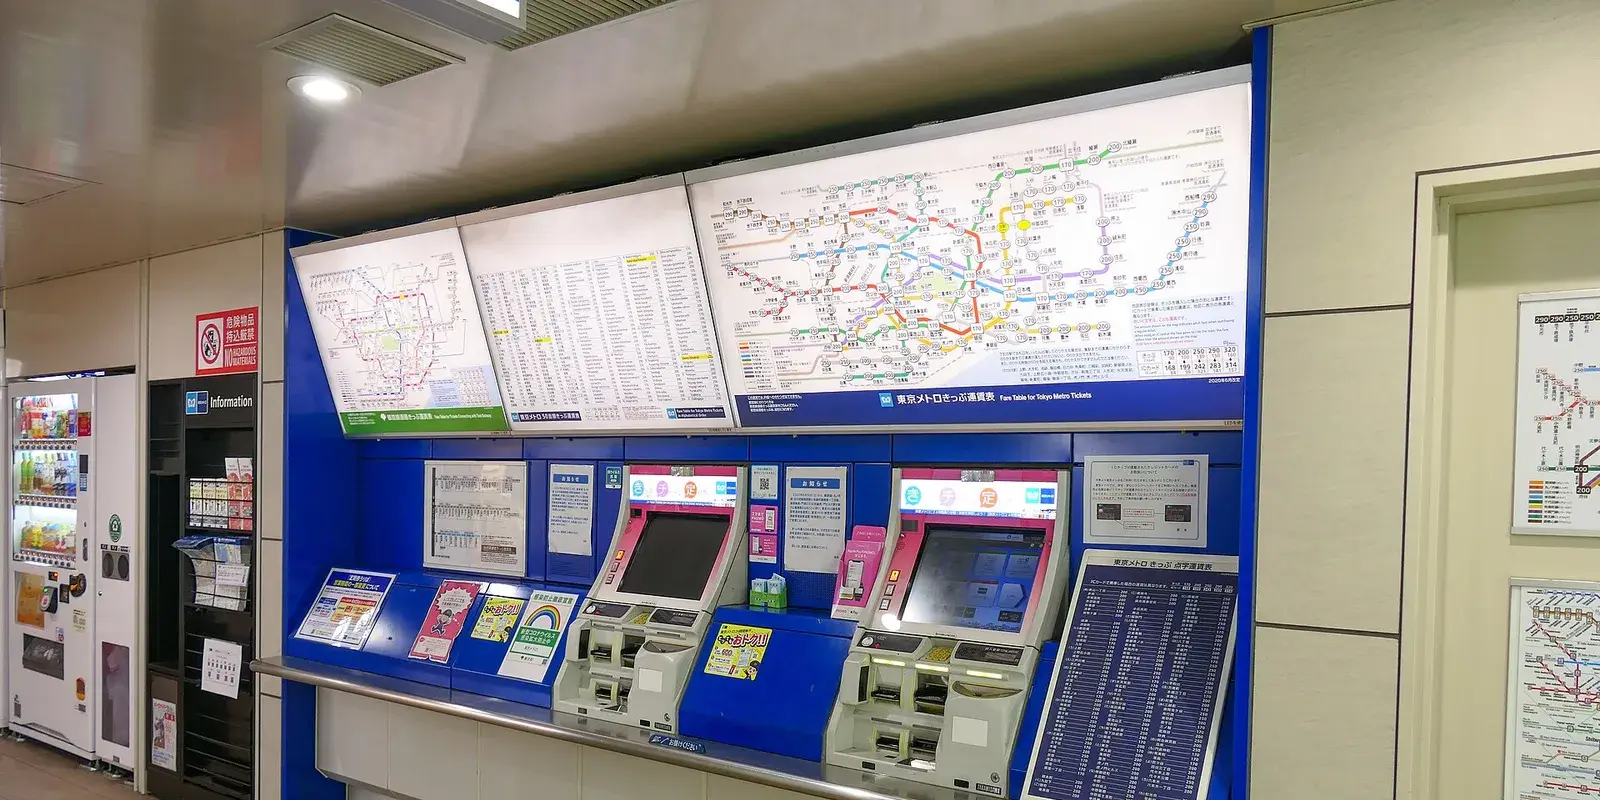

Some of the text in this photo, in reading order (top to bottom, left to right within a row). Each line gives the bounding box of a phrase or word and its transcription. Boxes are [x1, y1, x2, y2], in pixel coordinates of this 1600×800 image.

[226, 314, 254, 328] 危険物品
[226, 328, 254, 343] 持込厳禁
[233, 346, 256, 356] HAZARDOUS
[225, 349, 232, 367] NO
[233, 356, 256, 366] MATERIALS
[210, 395, 252, 408] Information
[898, 392, 995, 404] 東京メトロきっぷ運賃表
[685, 484, 696, 496] 定
[908, 487, 919, 503] き
[982, 490, 995, 505] 定
[521, 629, 556, 639] 新型コロナウイルス
